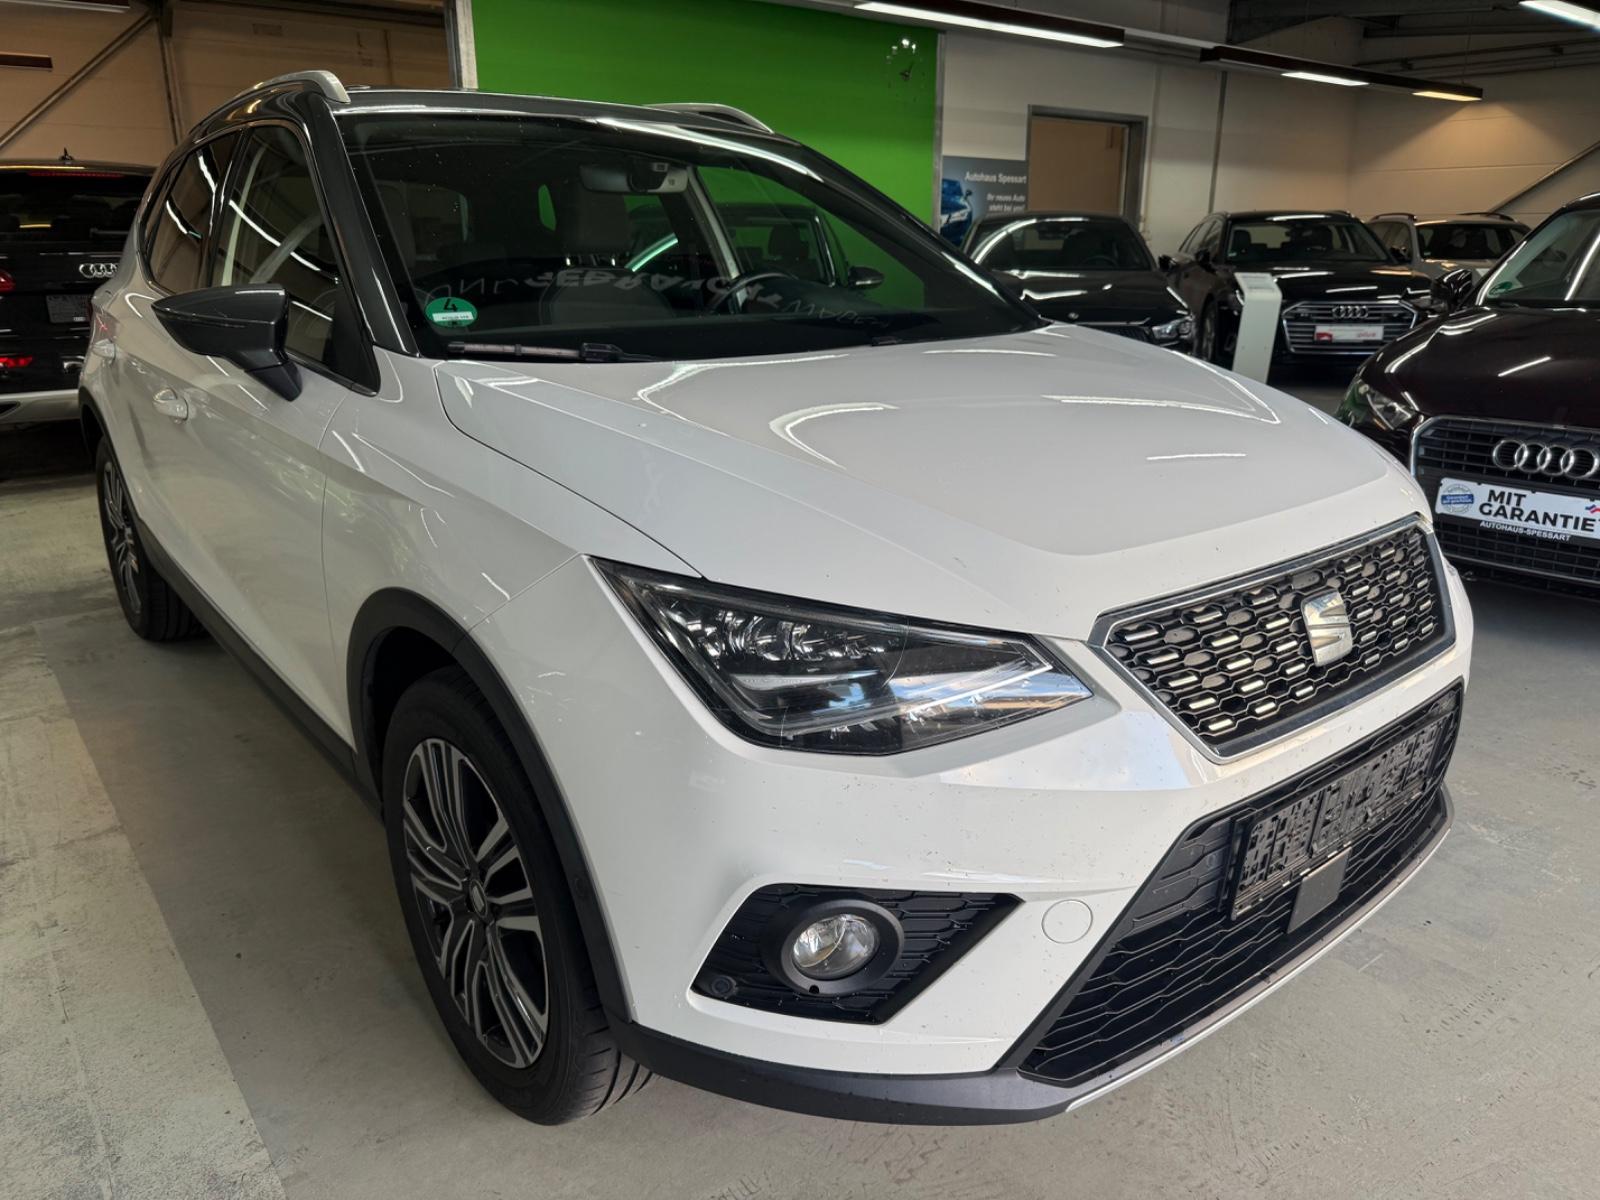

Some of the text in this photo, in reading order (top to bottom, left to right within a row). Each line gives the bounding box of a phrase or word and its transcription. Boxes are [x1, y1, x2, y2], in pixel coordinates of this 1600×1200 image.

[965, 171, 1027, 184] Autohaus Spessart
[443, 298, 458, 311] 4
[1487, 489, 1526, 507] MIT
[1478, 502, 1595, 532] GARANTIE
[1480, 520, 1571, 542] AUTOHAUS-SPESSART
